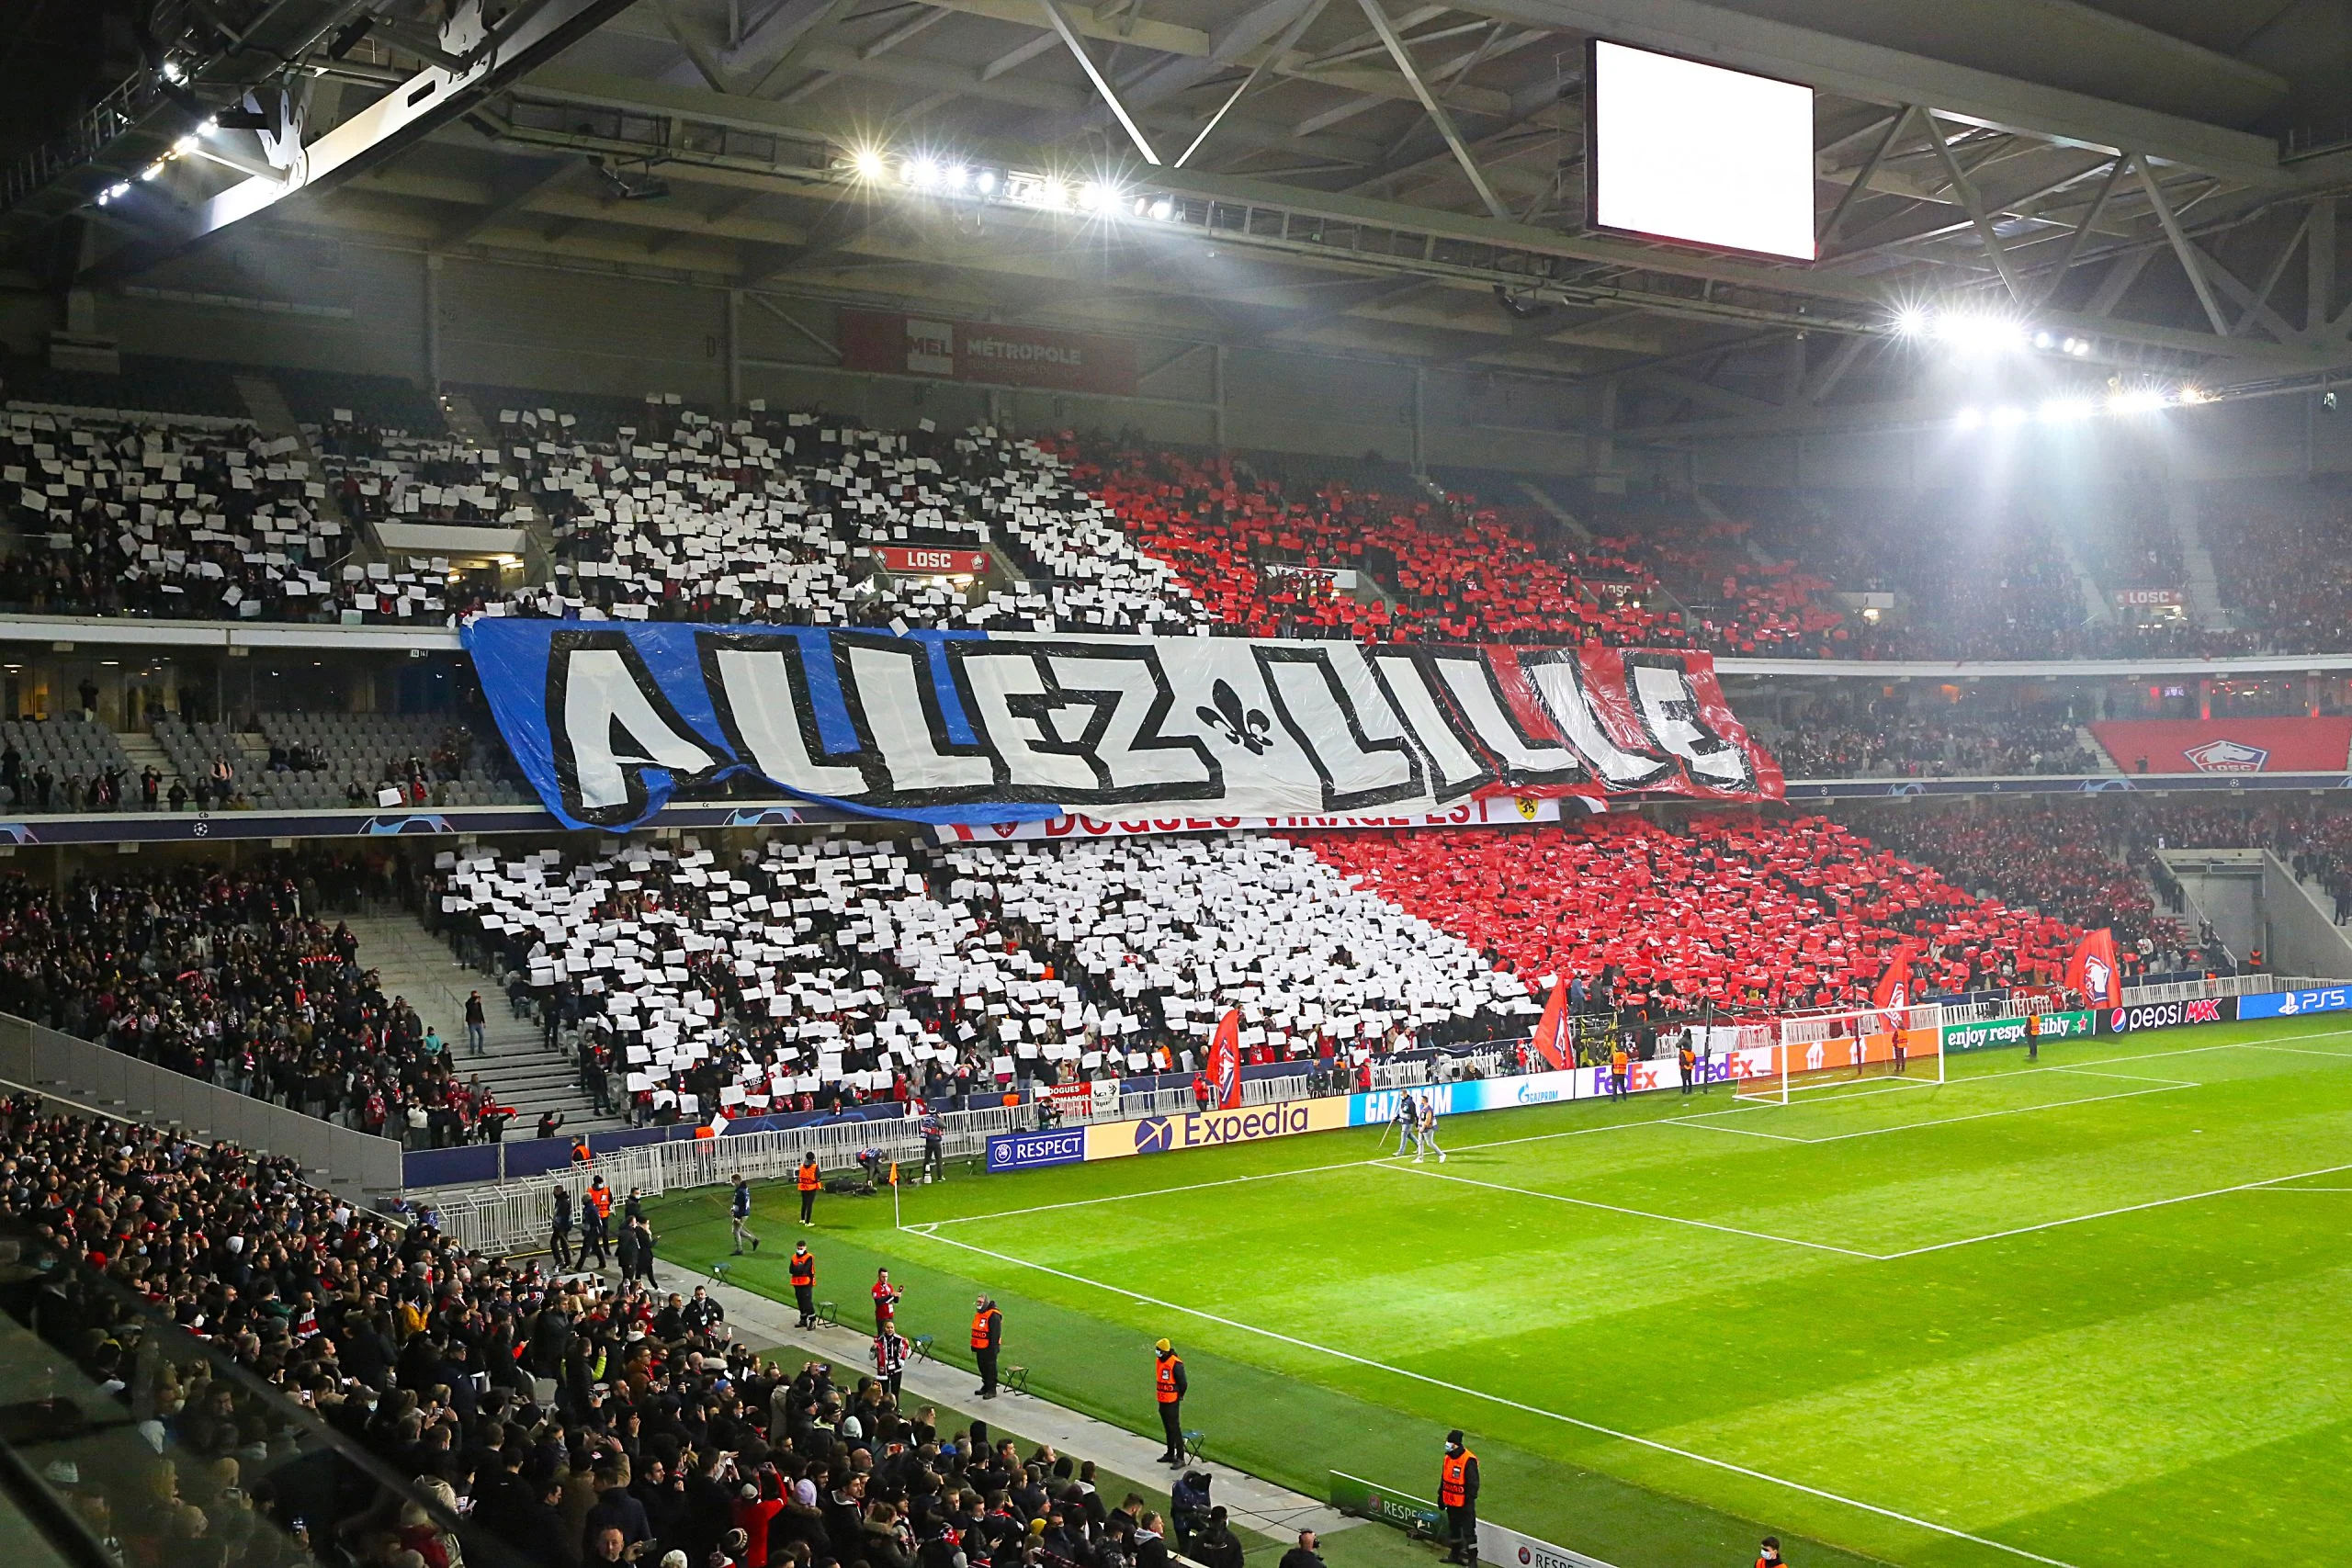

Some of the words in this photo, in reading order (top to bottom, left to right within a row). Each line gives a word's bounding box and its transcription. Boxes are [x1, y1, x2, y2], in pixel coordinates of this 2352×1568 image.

[967, 336, 1081, 366] MÉTROPOLE
[907, 551, 952, 568] LOSC
[2129, 591, 2169, 604] LOSC
[551, 628, 1226, 824] ALLEZ
[1251, 643, 1758, 812] LILLE
[2208, 764, 2252, 773] LOSC
[2302, 989, 2346, 1010] PS5
[2129, 1000, 2183, 1032] pepsi
[2184, 998, 2222, 1023] MAX
[1948, 1025, 1986, 1048] enjoy
[1989, 1017, 2070, 1043] resposibly
[1694, 1052, 1754, 1082] FedEx
[1529, 1090, 1559, 1102] GAZPROM
[1184, 1101, 1308, 1145] Expedia
[1016, 1137, 1082, 1159] RESPECT
